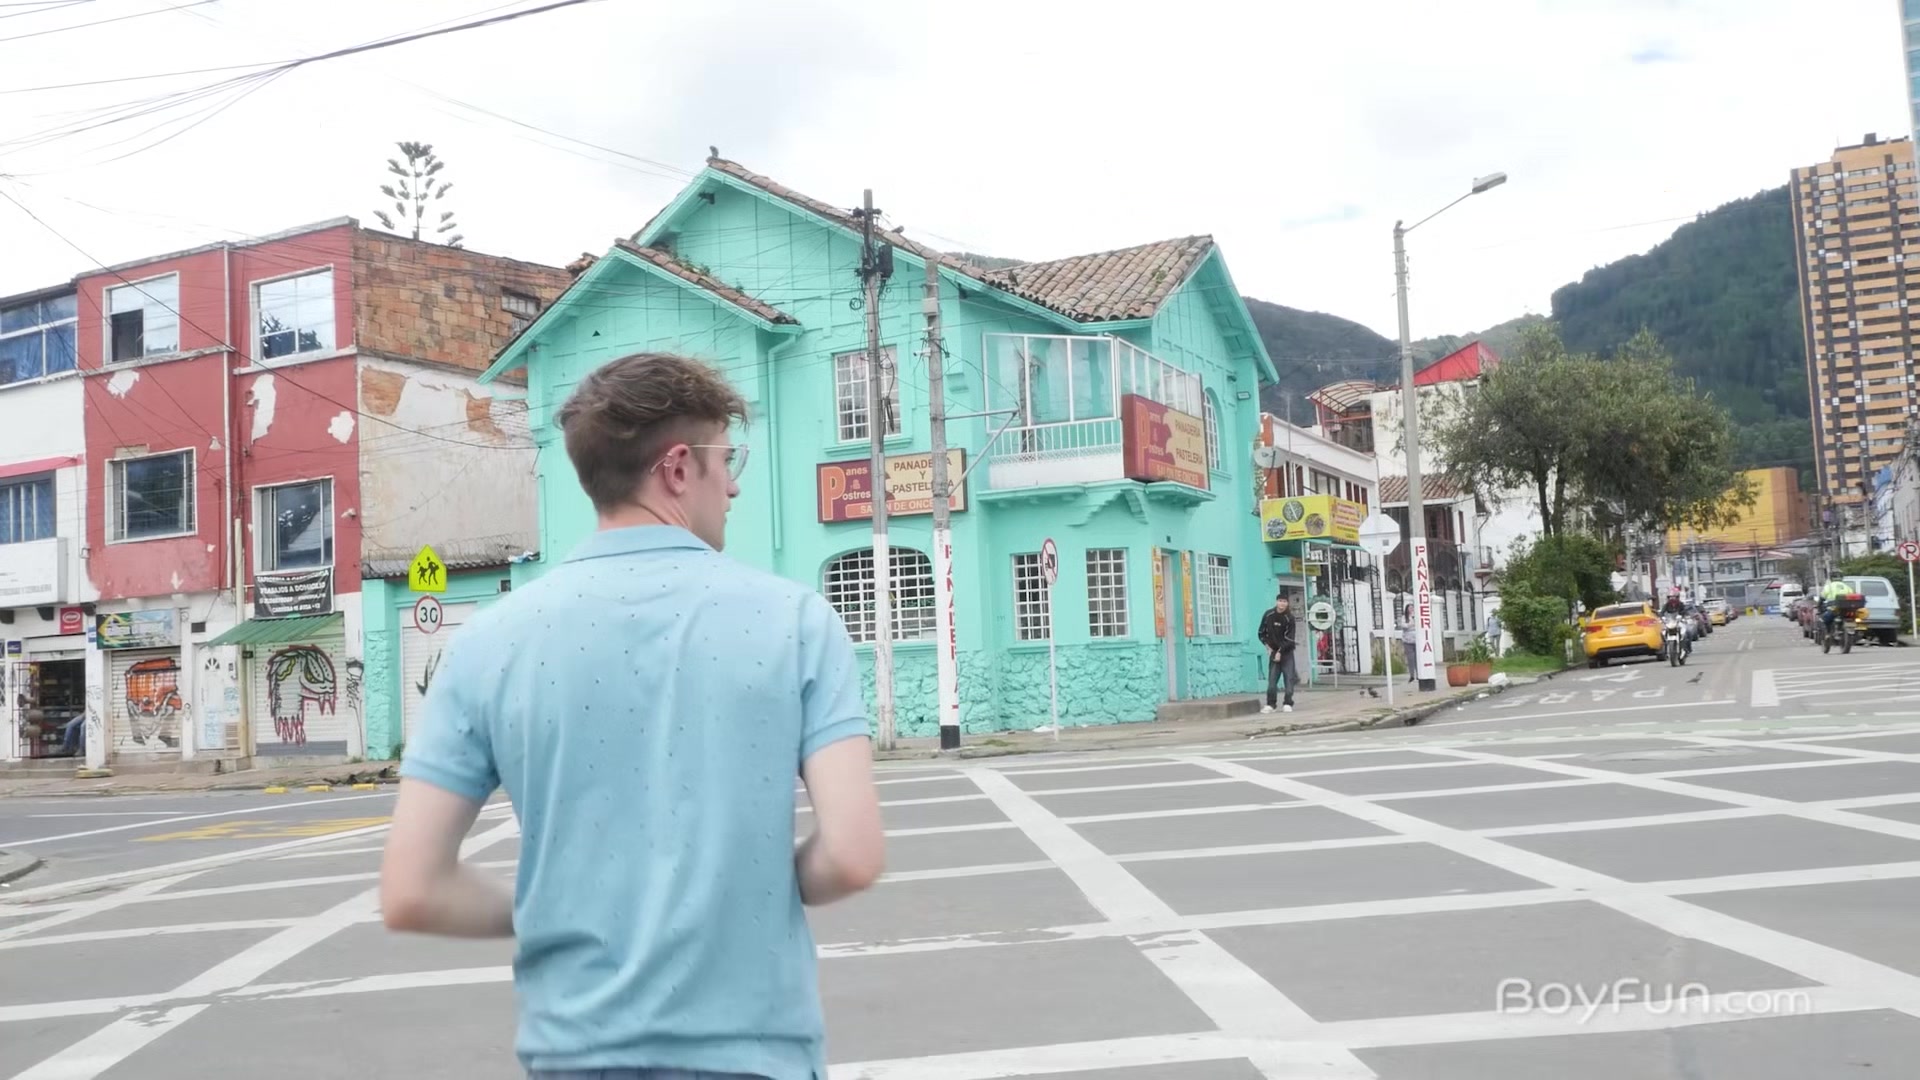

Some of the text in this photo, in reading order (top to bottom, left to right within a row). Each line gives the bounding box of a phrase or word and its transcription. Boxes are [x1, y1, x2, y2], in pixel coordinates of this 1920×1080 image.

[919, 471, 926, 480] Y
[894, 501, 906, 511] DE
[1906, 544, 1917, 559] P
[1415, 545, 1432, 652] PANADERIA
[420, 606, 438, 623] 30
